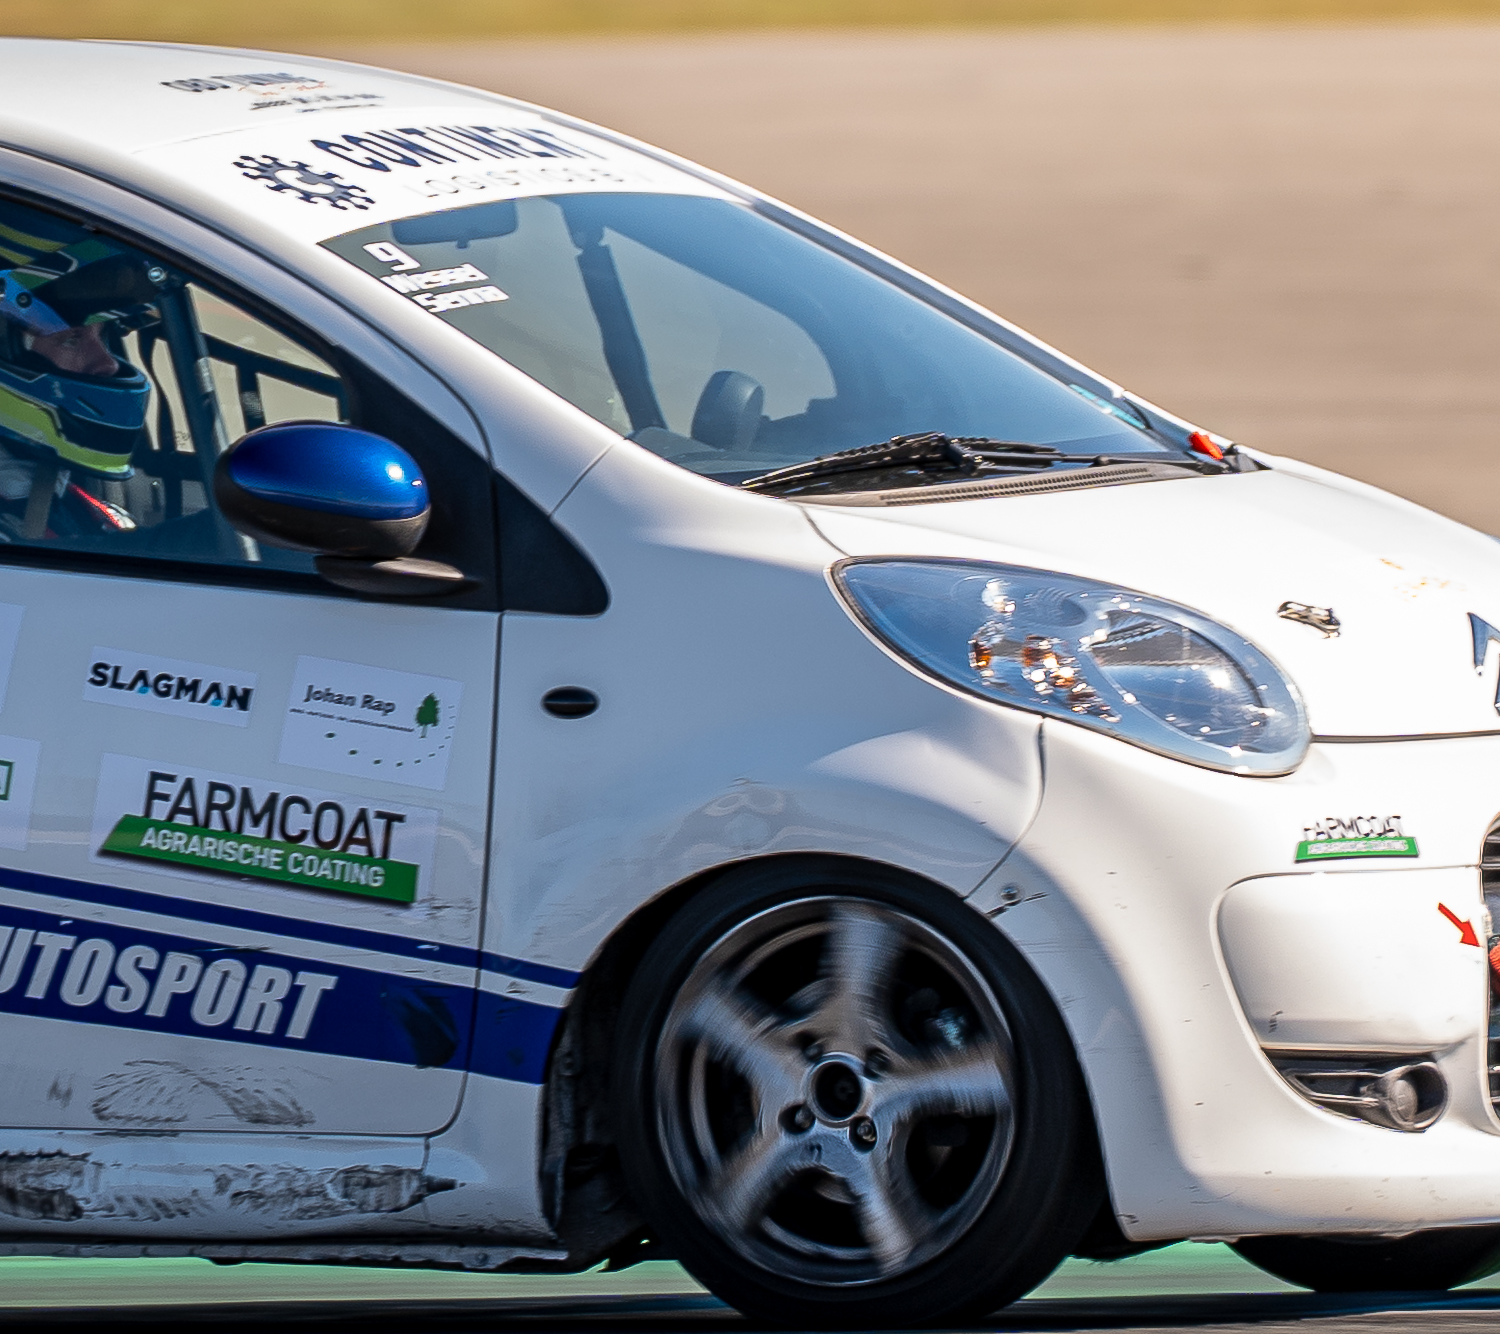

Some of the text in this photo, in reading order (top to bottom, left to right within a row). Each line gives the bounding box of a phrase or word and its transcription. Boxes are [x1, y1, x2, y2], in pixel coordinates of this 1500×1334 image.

[310, 125, 607, 173] CONTINENT
[362, 241, 421, 272] 9
[88, 661, 254, 712] SLAGMAN
[303, 684, 397, 717] Johan Rap
[143, 770, 407, 860] FARMCOAT
[140, 827, 386, 888] AGRARISCHE COATING
